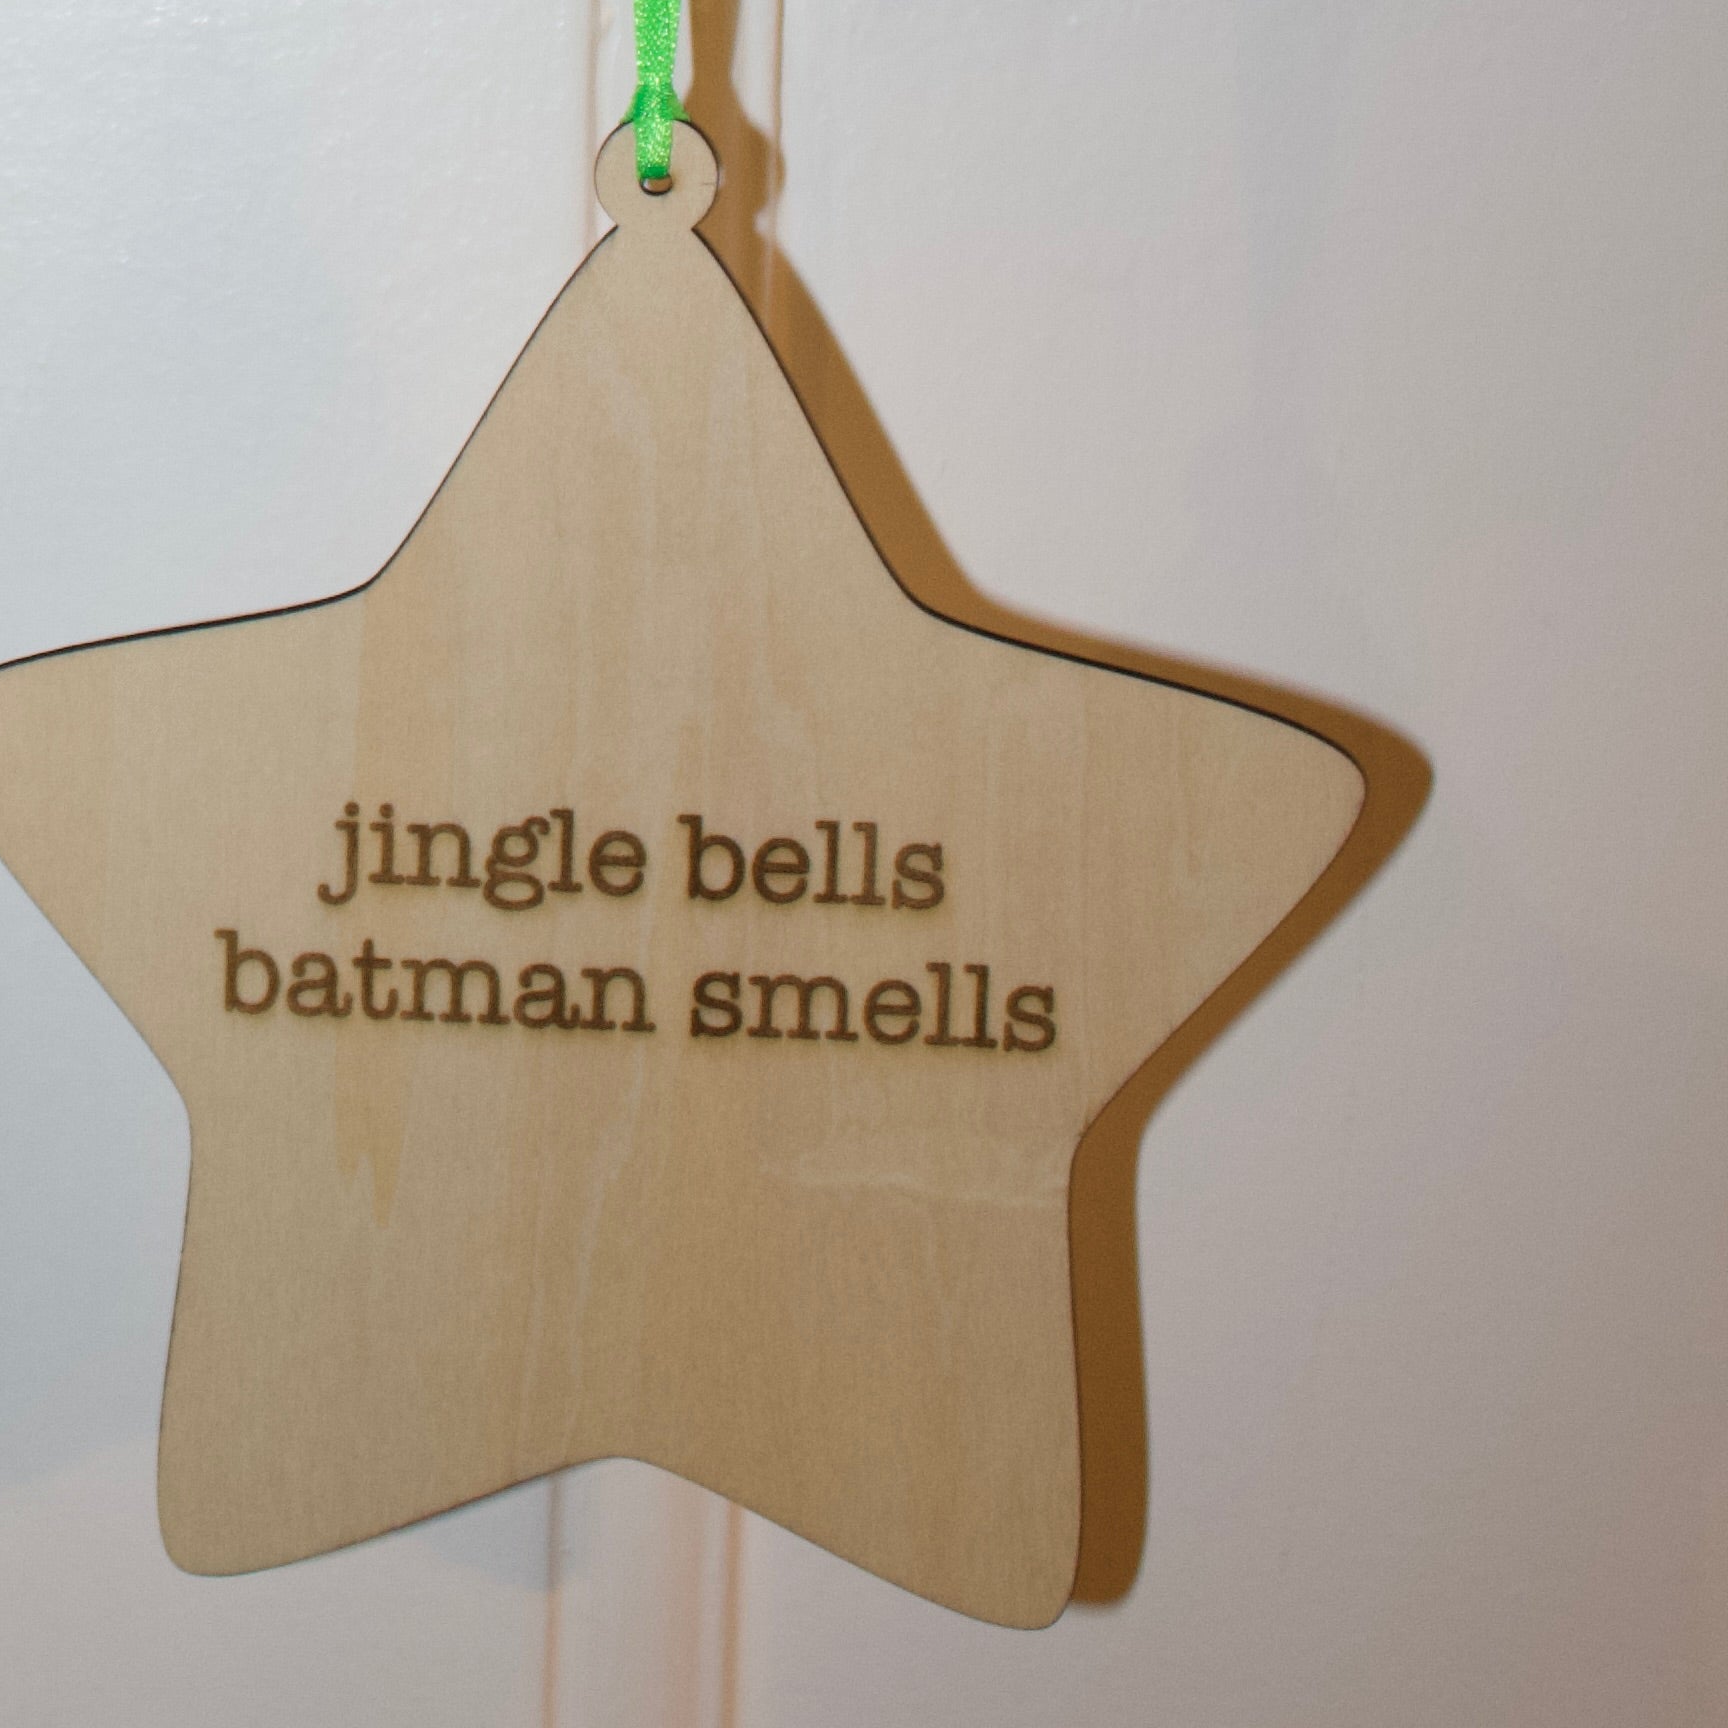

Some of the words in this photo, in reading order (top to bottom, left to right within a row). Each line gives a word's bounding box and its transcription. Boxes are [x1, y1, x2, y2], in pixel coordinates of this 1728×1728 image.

[317, 799, 648, 913] jingle
[676, 813, 947, 913] bells
[214, 928, 657, 1034] batman
[689, 962, 1057, 1054] smells
